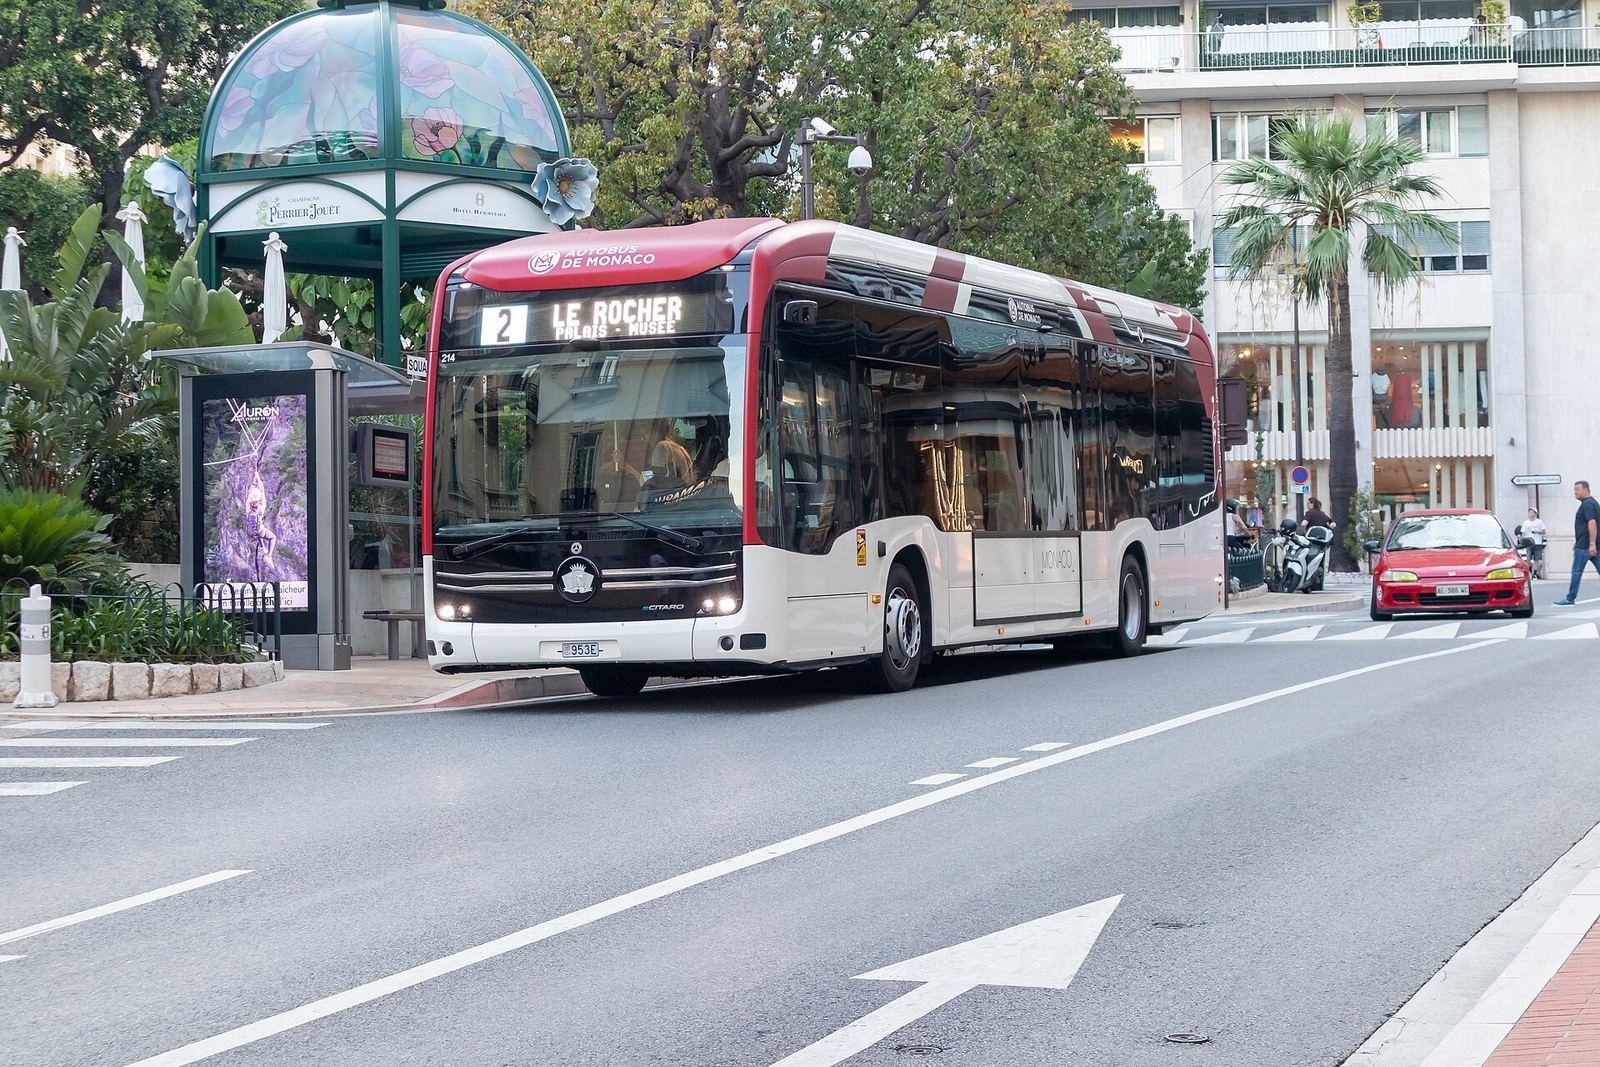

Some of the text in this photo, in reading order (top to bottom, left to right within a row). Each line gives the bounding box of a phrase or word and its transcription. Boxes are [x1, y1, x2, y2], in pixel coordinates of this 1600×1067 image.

[565, 245, 639, 257] AUTOBUS
[561, 254, 656, 270] DE MONACO
[553, 296, 682, 328] LE ROCHER
[496, 308, 512, 343] 2
[556, 324, 608, 341] PALAIS
[629, 320, 676, 337] MUSEE
[441, 353, 456, 363] 214
[1041, 550, 1072, 569] MONACO
[571, 644, 597, 656] 953E
